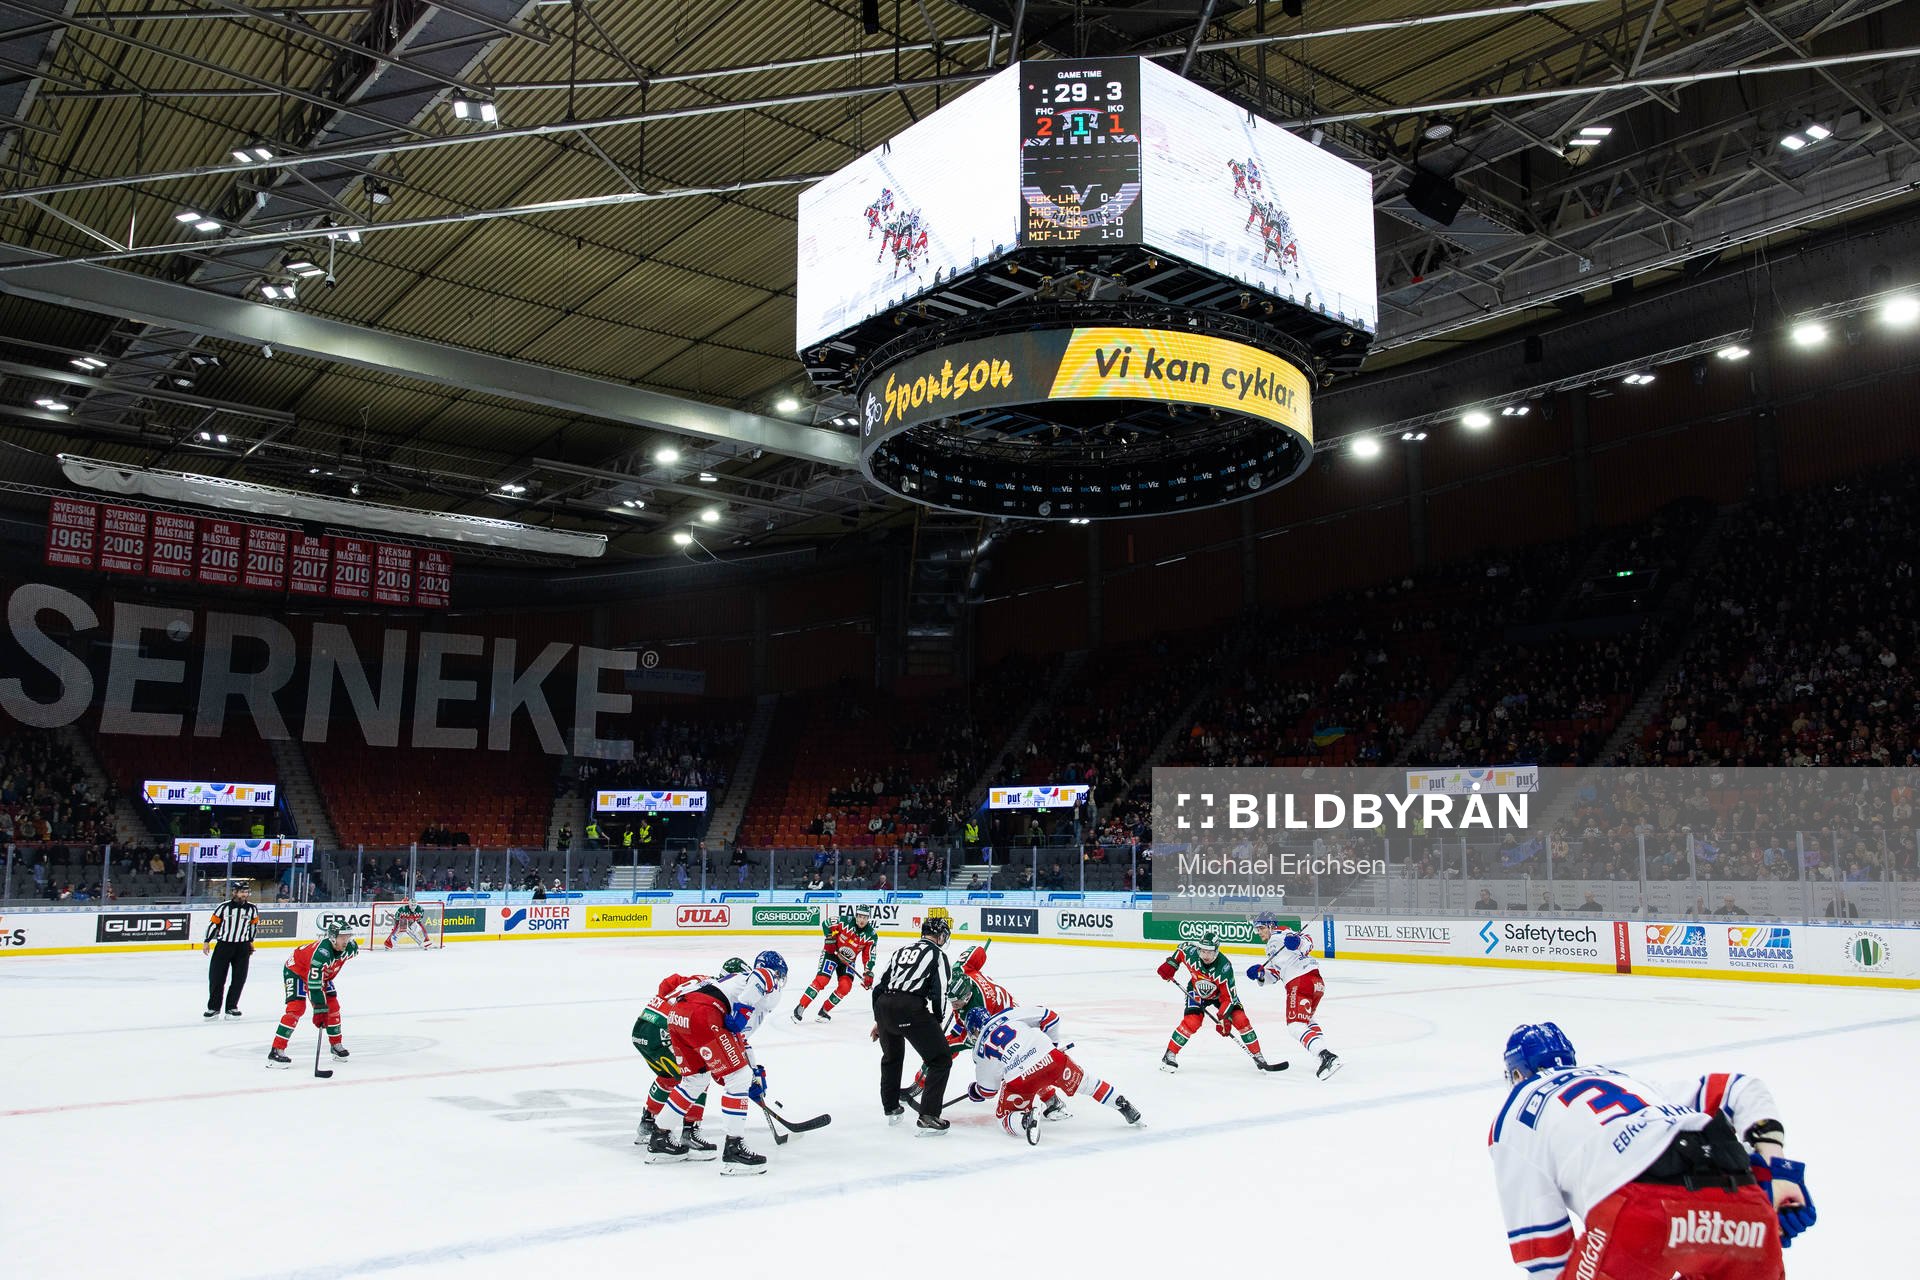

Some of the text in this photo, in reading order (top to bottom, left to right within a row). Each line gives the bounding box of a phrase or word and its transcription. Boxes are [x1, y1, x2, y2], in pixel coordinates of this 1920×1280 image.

[1108, 104, 1124, 112] IKO
[1036, 117, 1053, 136] 2
[1072, 116, 1089, 136] 1
[1109, 114, 1124, 133] 1
[1100, 192, 1123, 202] 0-2
[1029, 206, 1081, 217] FHC-IKO
[1029, 217, 1088, 229] HV71-SKE
[1101, 216, 1123, 226] 1-0
[1029, 228, 1123, 240] MIF-LIF 1-0
[1094, 346, 1132, 378] Vi
[1144, 354, 1210, 384] kan
[884, 358, 1013, 424] Sportson
[54, 502, 96, 516] SVENSKA
[106, 509, 146, 523] SVENSKA
[156, 516, 195, 530] SVENSKA
[214, 524, 230, 534] CHL
[50, 528, 92, 549] 1965
[250, 528, 286, 542] SVENSKA
[304, 536, 320, 547] CHL
[103, 536, 144, 555] 2003
[154, 542, 192, 561] 2005
[347, 543, 362, 552] CHL
[378, 546, 412, 558] SVENSKA
[200, 548, 238, 568] 2016
[248, 554, 284, 574] 2016
[293, 560, 328, 579] 2017
[336, 564, 370, 584] 2019
[377, 570, 411, 589] 2019
[419, 575, 450, 592] 2020
[0, 582, 638, 760] SERNEKE
[1429, 778, 1445, 791] put
[1516, 774, 1534, 788] put
[168, 788, 185, 800] put
[255, 790, 271, 802] put
[1008, 793, 1020, 804] put
[617, 796, 631, 808] put
[689, 796, 703, 807] put
[200, 844, 217, 858] put
[529, 907, 569, 918] INTER
[602, 913, 648, 923] Ramudden
[679, 909, 728, 923] JULA
[757, 911, 811, 922] CASHBUDDY
[838, 905, 899, 919] FATASY
[105, 919, 182, 932] GUIDE
[425, 916, 475, 926] Assemblin
[529, 917, 570, 930] SPORT
[987, 915, 1031, 927] BRIXLY
[1061, 913, 1113, 928] FRAGUS
[1181, 924, 1252, 938] CASHBUDDY
[1345, 925, 1450, 940] TRAVEL SERVICE
[1505, 923, 1596, 945] Safetytech
[898, 949, 920, 964] 89
[1505, 945, 1597, 957] PART OF PROSERO
[1647, 945, 1708, 957] HAGMANS
[1729, 948, 1793, 960] HAGMANS
[311, 968, 319, 979] 5
[720, 1034, 740, 1066] coolcon
[1002, 1042, 1020, 1064] PLATO
[1558, 1078, 1650, 1125] 3
[1668, 1210, 1766, 1248] plåtson
